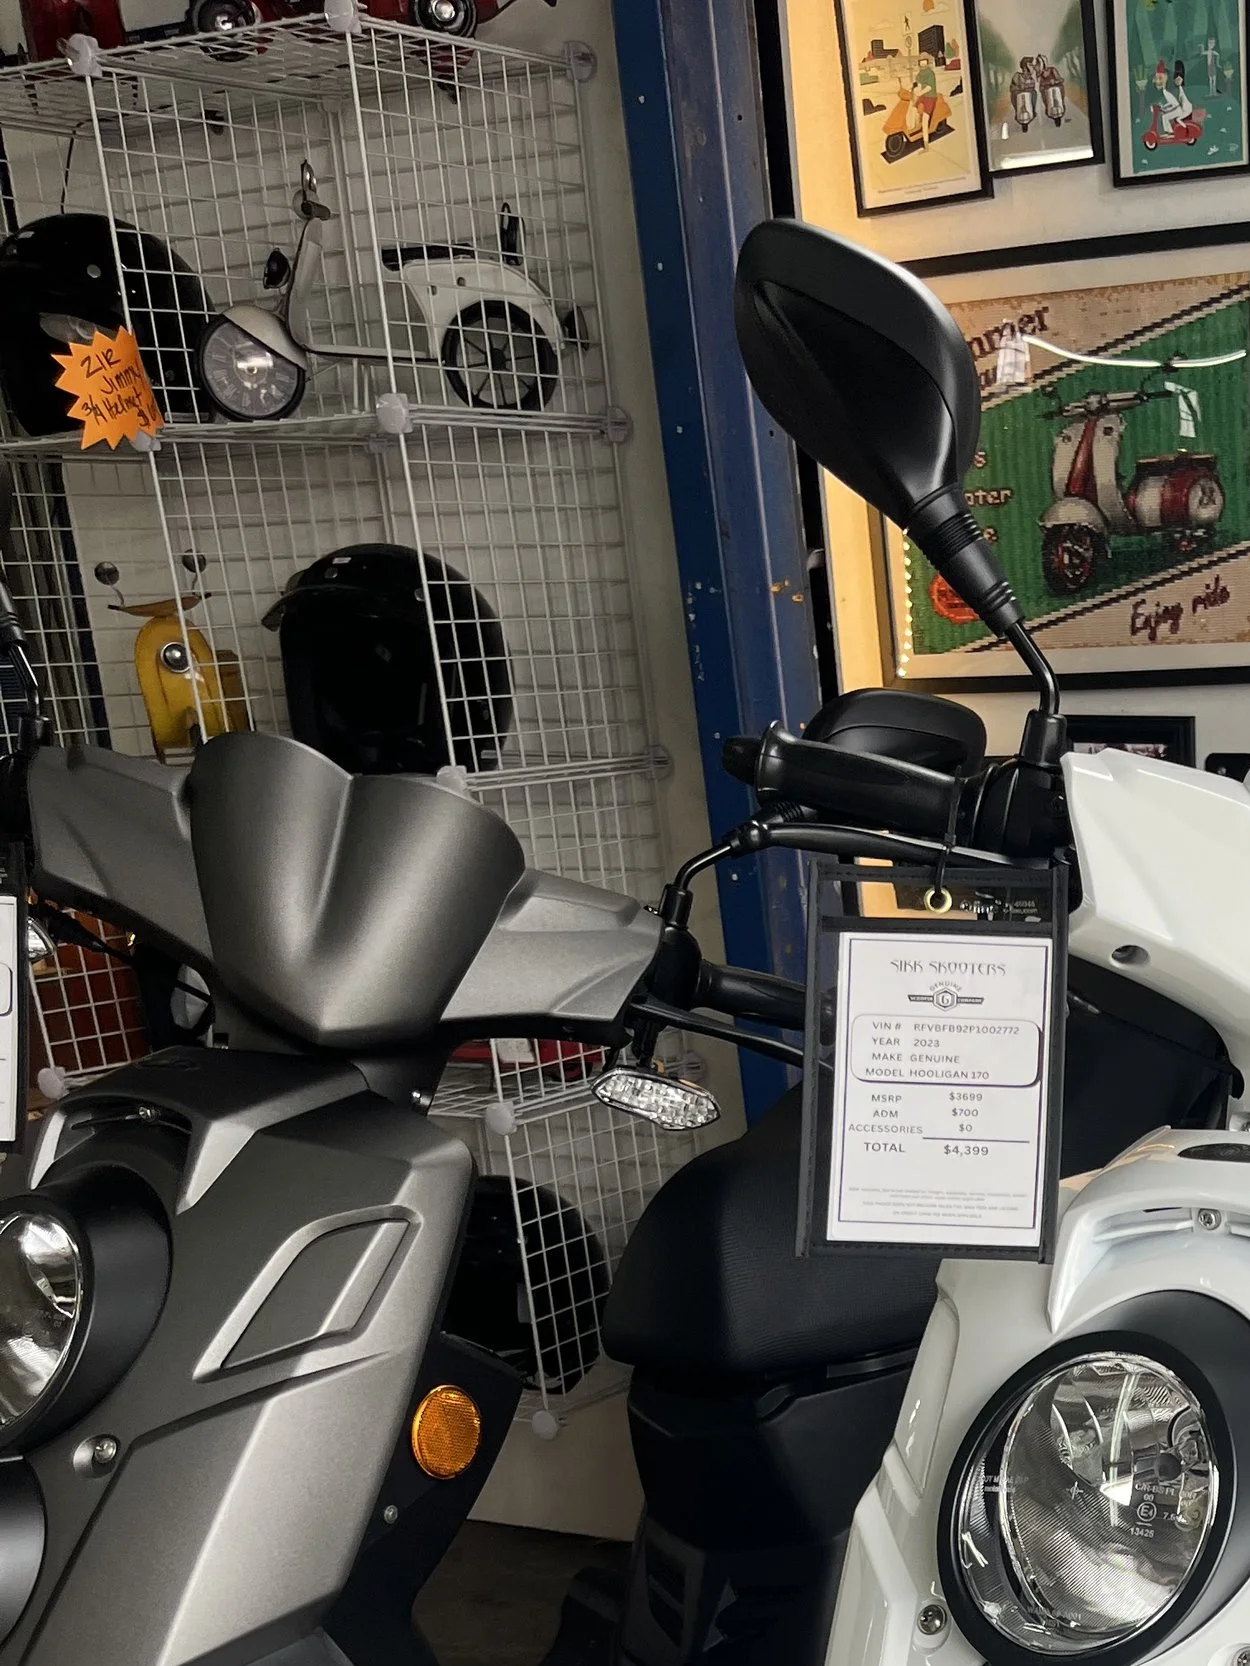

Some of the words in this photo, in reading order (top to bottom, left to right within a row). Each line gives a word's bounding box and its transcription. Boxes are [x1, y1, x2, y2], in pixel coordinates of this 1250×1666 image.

[929, 980, 963, 992] GENUINE
[872, 1021, 892, 1031] VIN
[872, 1036, 901, 1046] YEAR
[913, 1039, 941, 1048] 2023
[872, 1052, 903, 1062] MAKE
[910, 1053, 960, 1064] GENUINE
[865, 1067, 904, 1078] MODEL
[909, 1068, 969, 1079] HOOLIGAN
[971, 1071, 990, 1080] 170
[871, 1093, 902, 1103] MSRP
[949, 1092, 983, 1102] $3699
[872, 1109, 899, 1119] ADM
[951, 1108, 979, 1117] $700
[848, 1123, 924, 1134] ACCESSORIES
[958, 1123, 973, 1133] $0
[863, 1141, 906, 1153] TOTAL
[943, 1144, 989, 1157] $4,399
